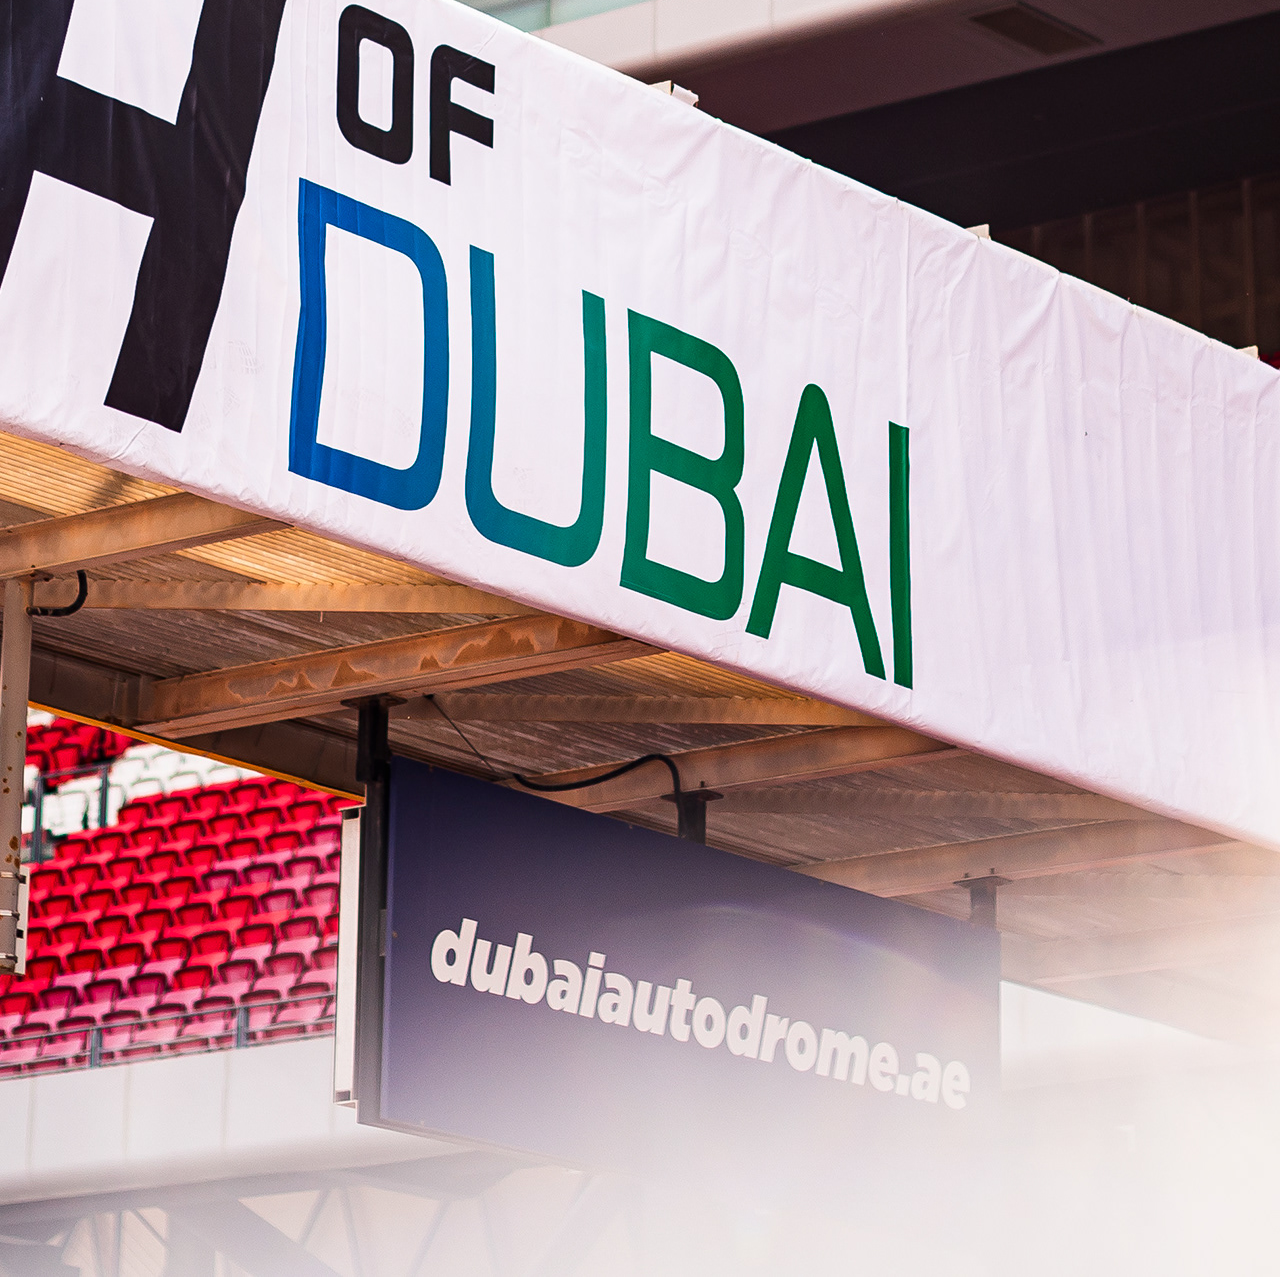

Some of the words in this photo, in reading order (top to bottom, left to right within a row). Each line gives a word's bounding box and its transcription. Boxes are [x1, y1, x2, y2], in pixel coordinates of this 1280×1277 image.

[336, 3, 496, 186] OF
[288, 177, 913, 689] DUBAI
[430, 917, 972, 1110] dubaiautodrome.ae
